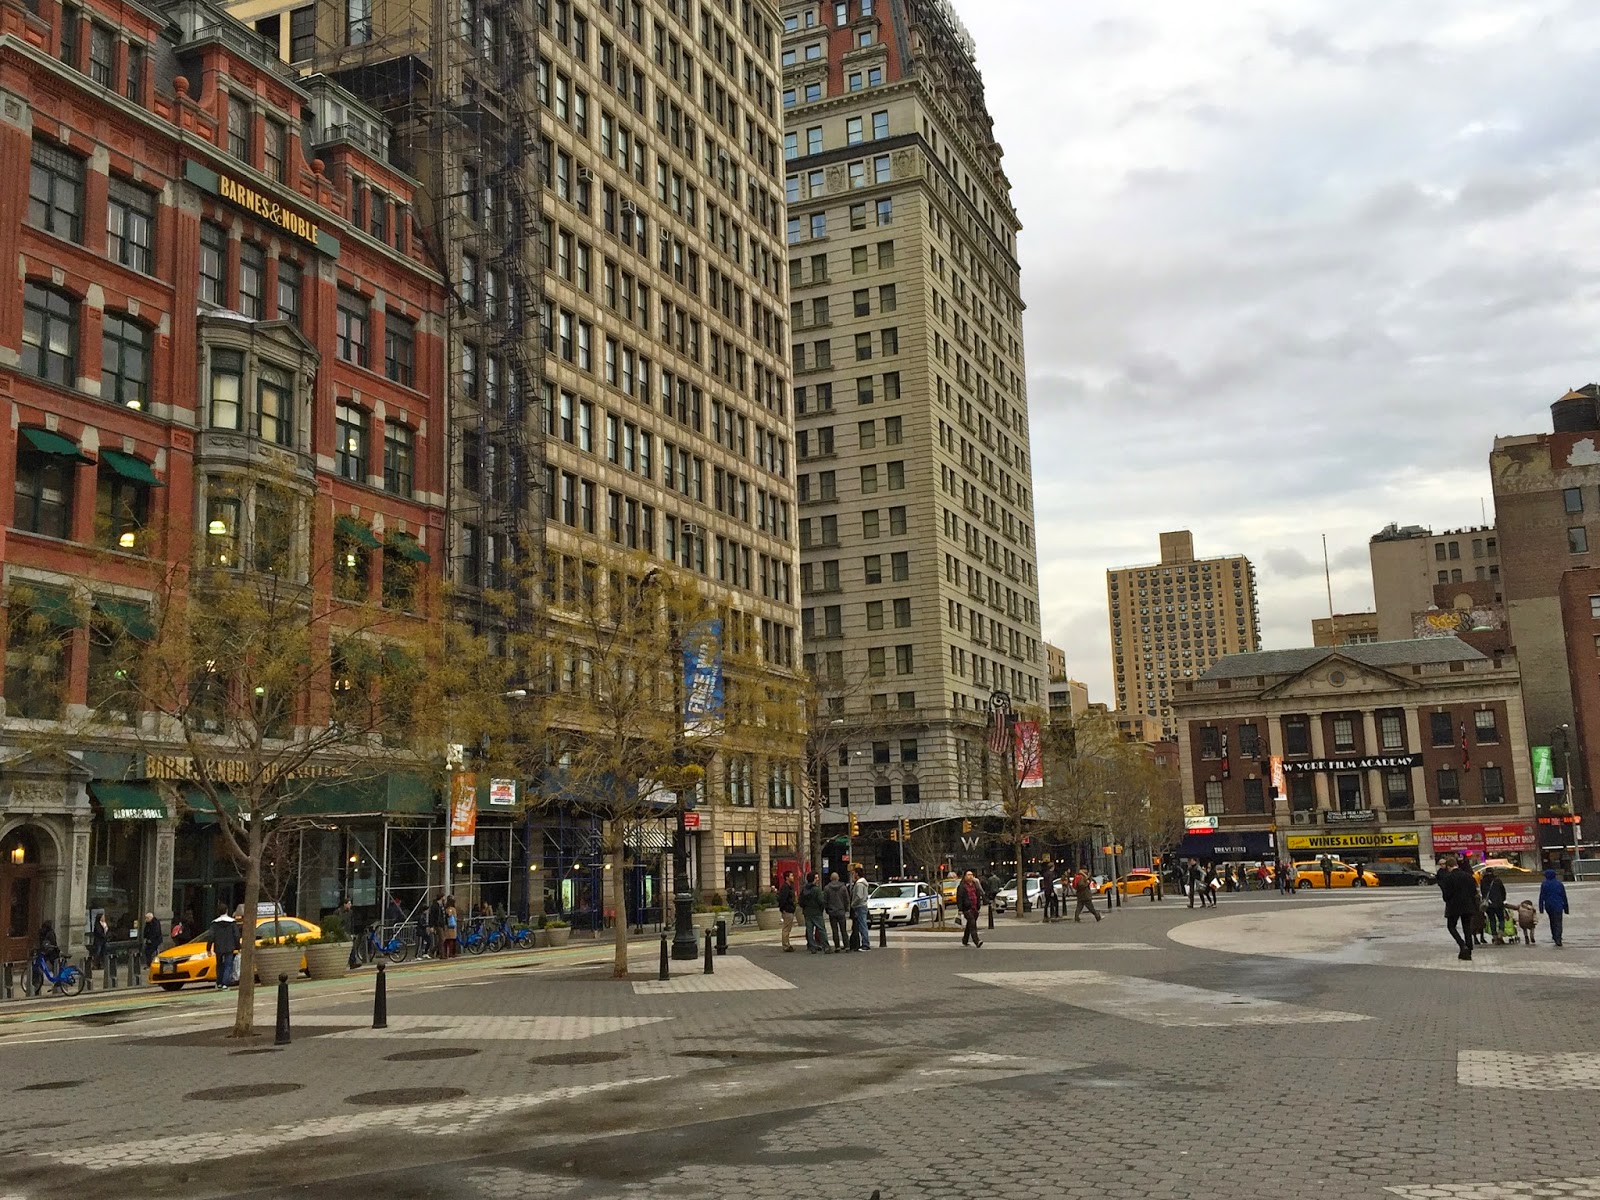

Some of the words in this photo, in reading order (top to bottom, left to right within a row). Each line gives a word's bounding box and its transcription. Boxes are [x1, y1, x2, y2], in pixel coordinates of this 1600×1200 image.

[1296, 762, 1327, 771] YORK
[1329, 761, 1357, 770] FILM
[1359, 757, 1413, 768] ACADEMY
[961, 836, 979, 851] W
[1309, 837, 1341, 847] WINES
[1349, 836, 1394, 846] LIQUORS
